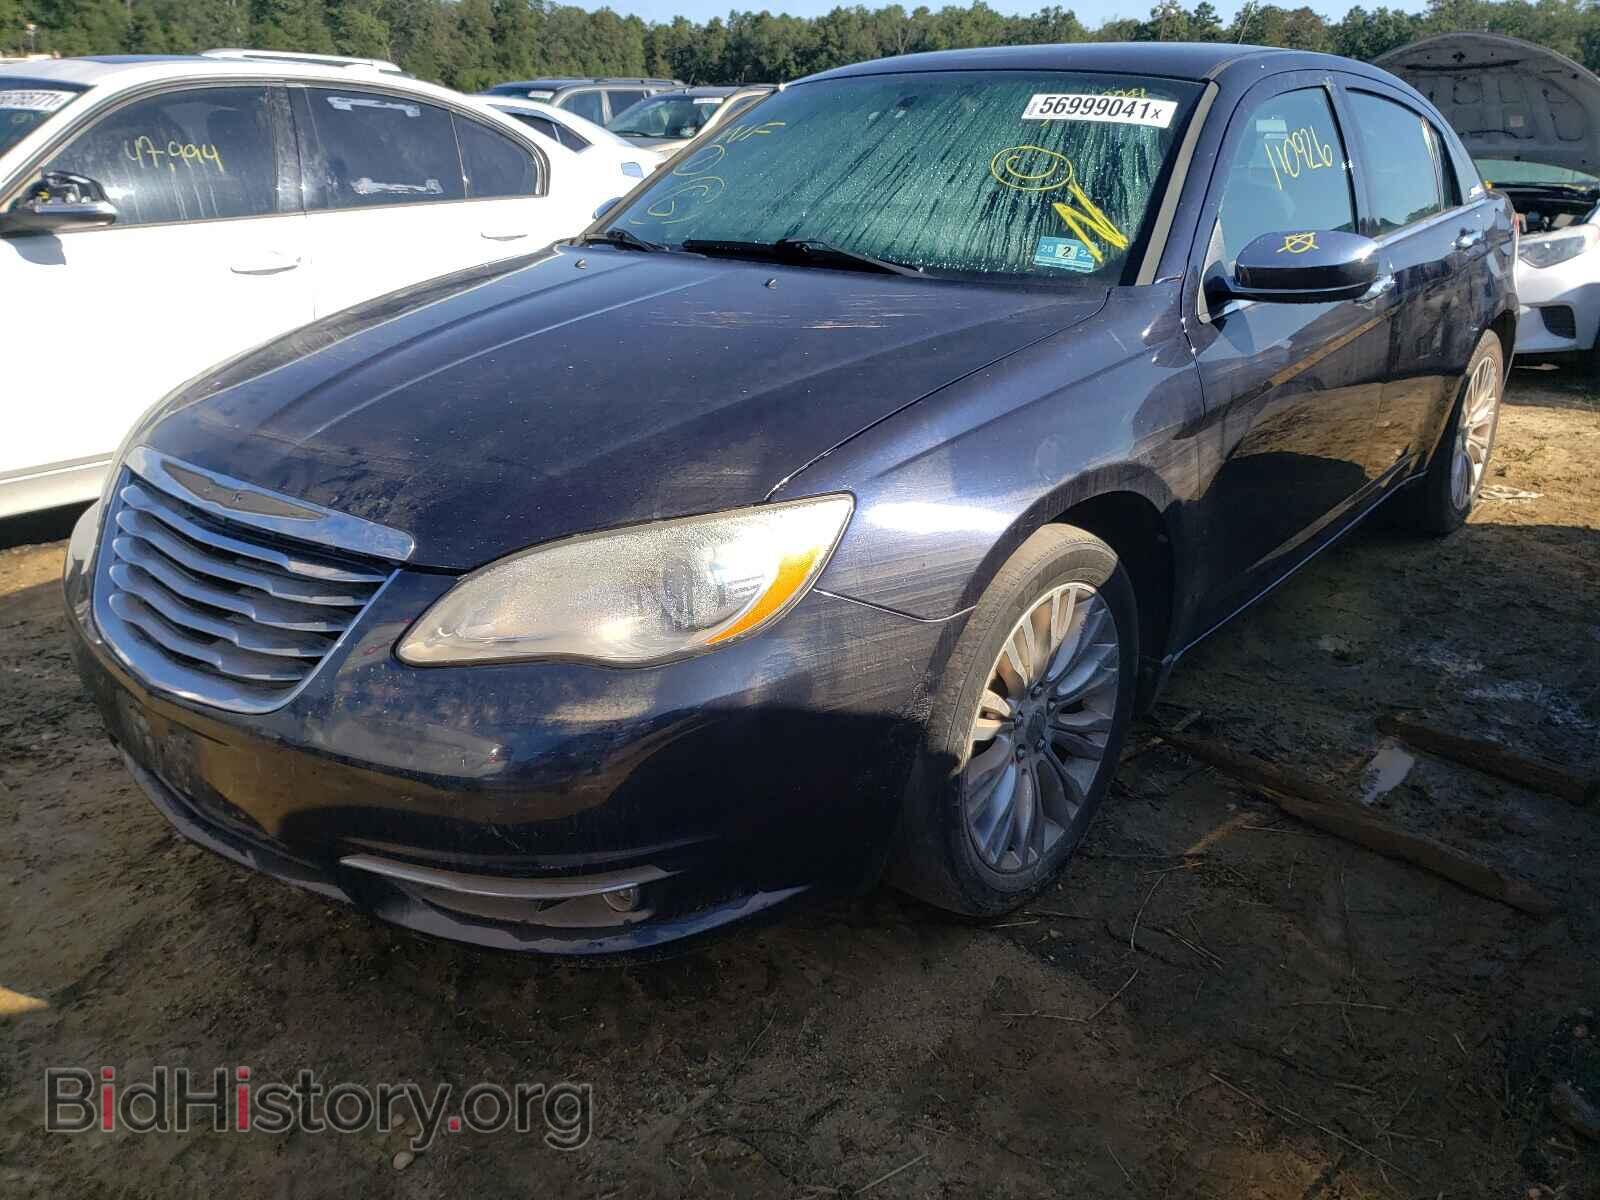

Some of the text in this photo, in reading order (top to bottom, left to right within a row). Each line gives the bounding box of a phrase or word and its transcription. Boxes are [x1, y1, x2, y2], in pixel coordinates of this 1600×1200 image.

[124, 135, 225, 175] 47,994
[1264, 125, 1333, 191] 110926
[1062, 246, 1072, 257] 2
